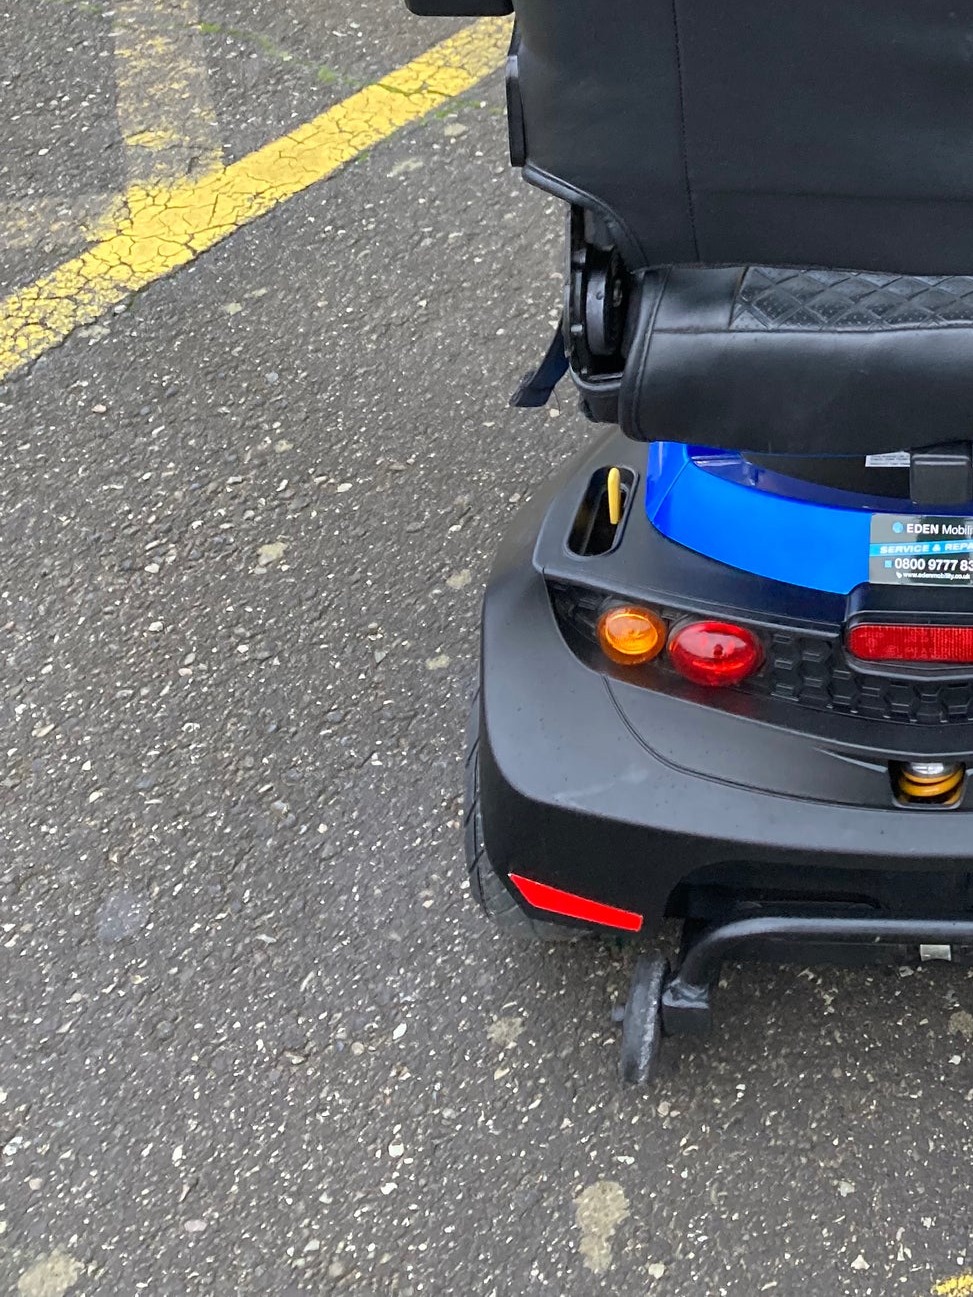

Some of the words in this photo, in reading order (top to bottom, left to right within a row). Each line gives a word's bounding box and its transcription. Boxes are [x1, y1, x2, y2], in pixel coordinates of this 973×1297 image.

[906, 523, 939, 534] EDEN
[880, 544, 930, 555] SERVICE
[932, 543, 941, 552] &
[895, 558, 926, 570] 0800
[928, 559, 959, 571] 9777
[903, 572, 971, 580] www.edenmobility.co.uk
